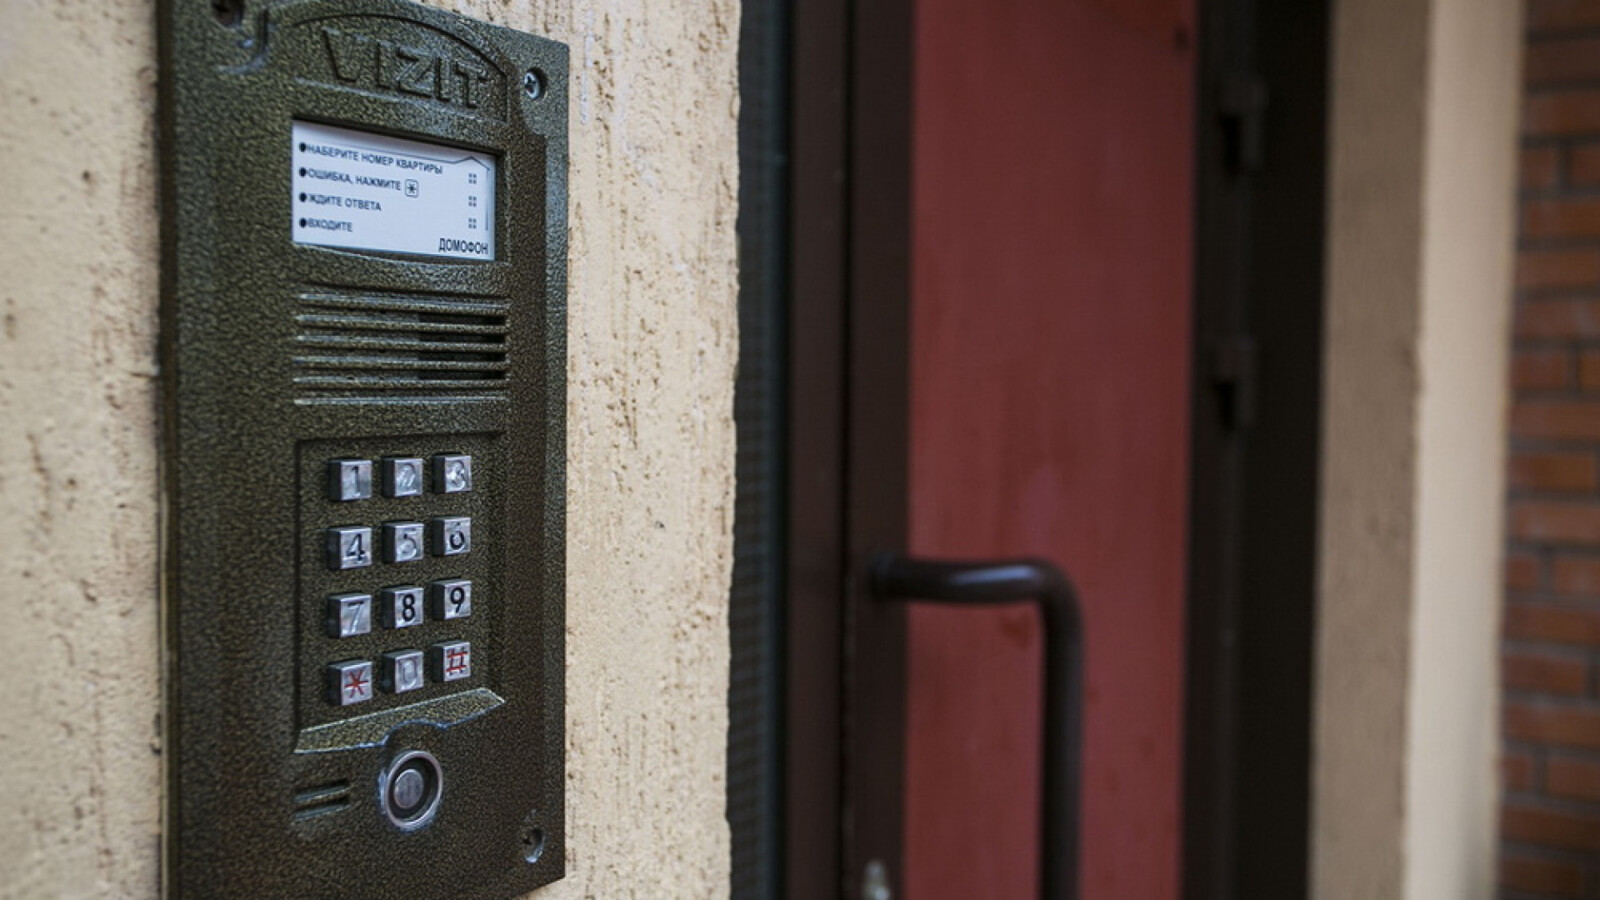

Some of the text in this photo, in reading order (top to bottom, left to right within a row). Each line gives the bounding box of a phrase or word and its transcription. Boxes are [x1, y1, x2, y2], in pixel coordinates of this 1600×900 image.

[321, 26, 489, 109] VIZIT
[306, 143, 443, 174] НАБЕРИТЕ НОМЕР КВАРТИРЫ
[307, 168, 353, 185] ОШИБКА,
[355, 175, 401, 191] НАЖМИТЕ
[308, 193, 382, 211] ЖДИТЕ ОТВЕТА
[307, 217, 353, 232] ВХОДИТЕ
[438, 237, 489, 255] ДОМОФОН
[351, 465, 361, 497] 1
[346, 521, 466, 562] 4 5 6
[346, 586, 466, 634] 7 8 9
[401, 657, 418, 690] 0
